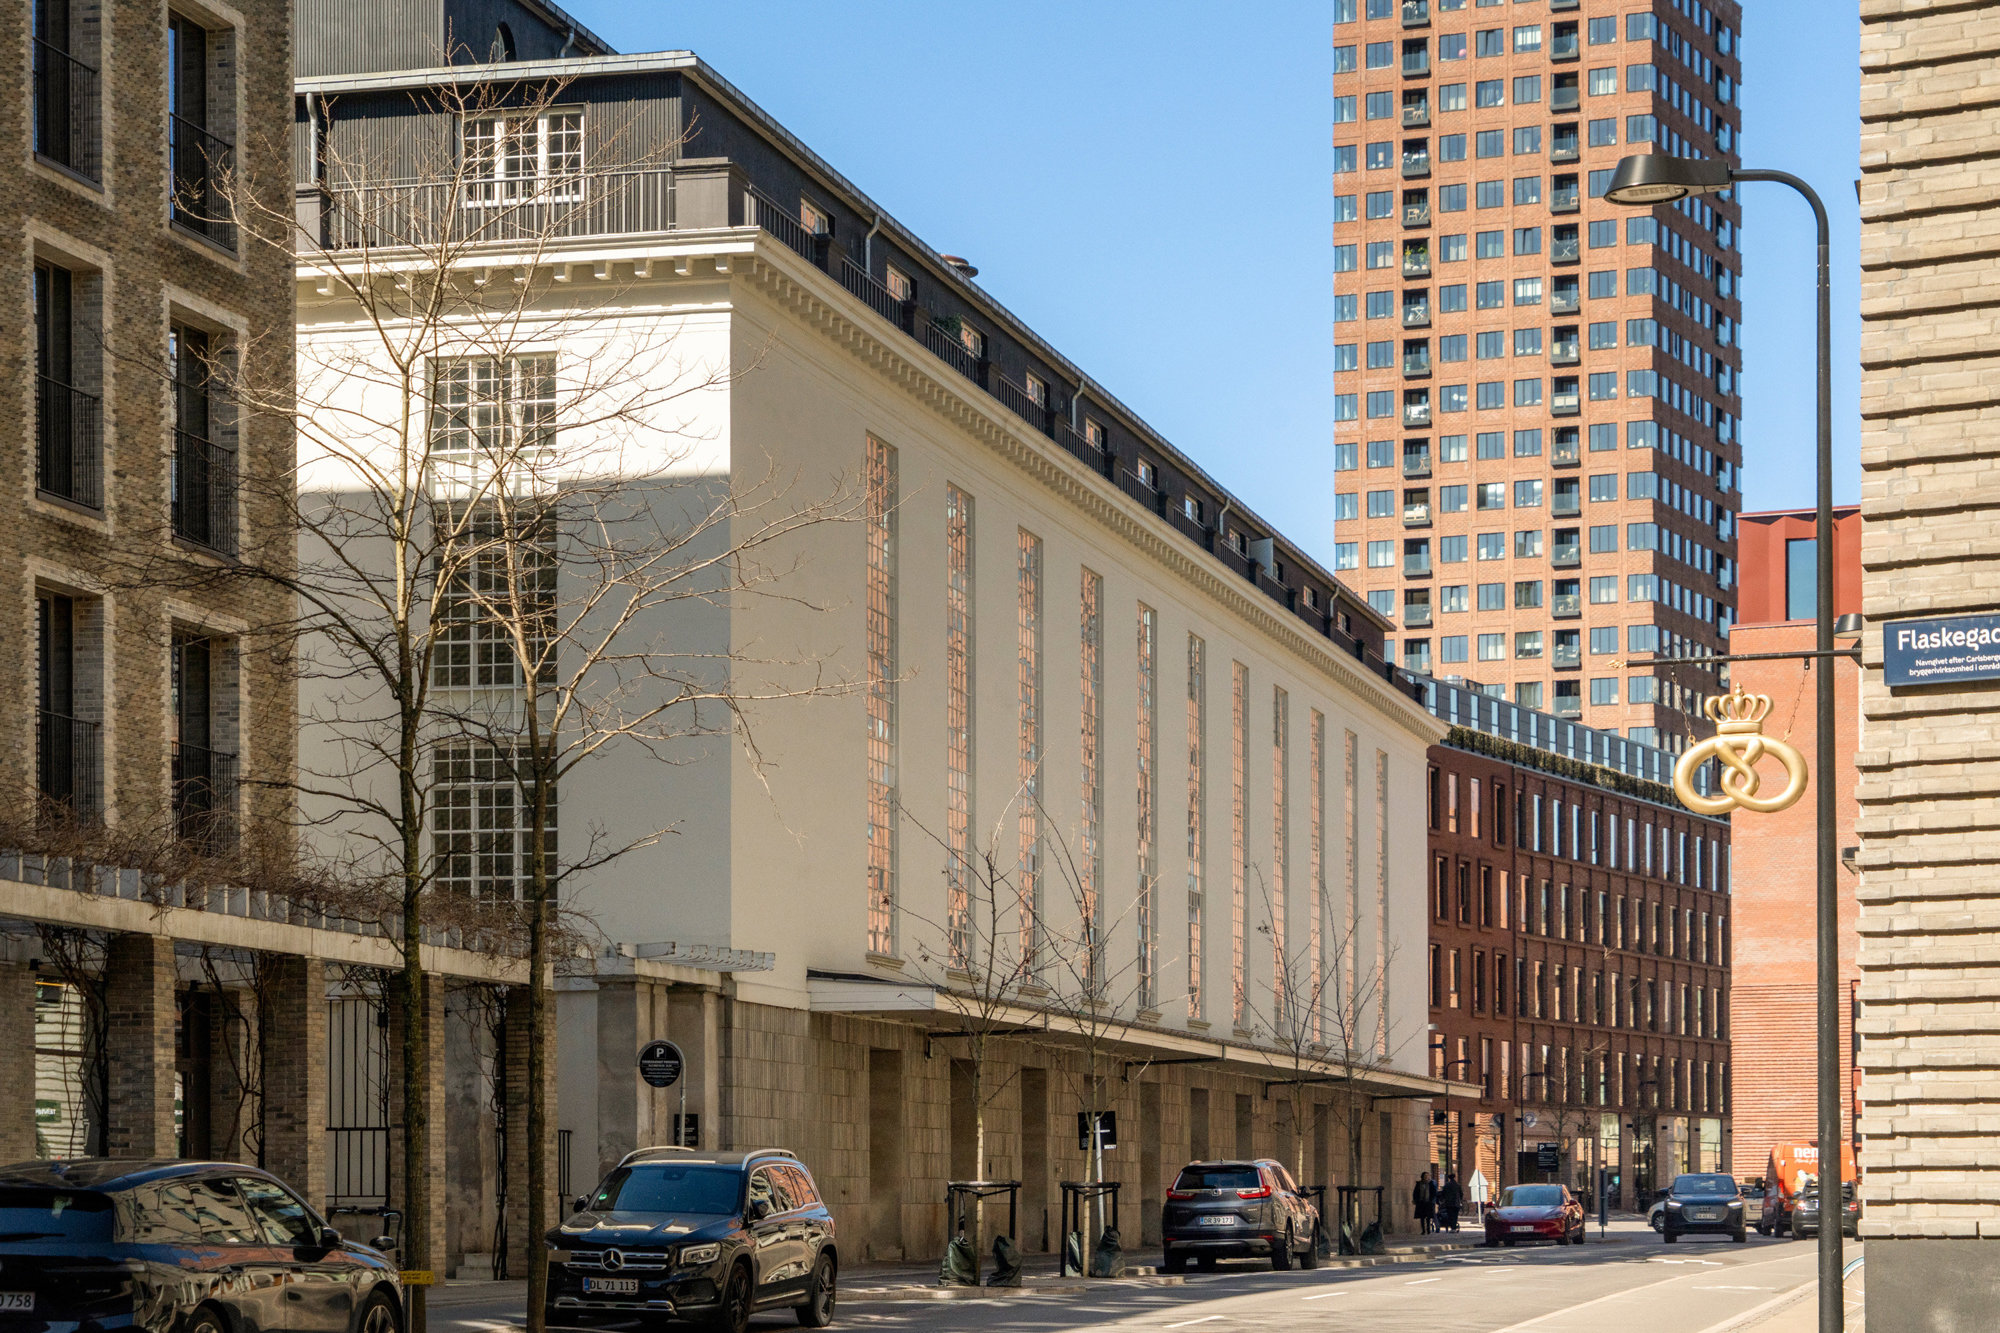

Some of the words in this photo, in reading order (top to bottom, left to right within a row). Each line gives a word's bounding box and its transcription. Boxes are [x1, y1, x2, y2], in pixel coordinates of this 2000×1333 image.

[1916, 657, 1948, 667] Navngivet
[1949, 656, 1965, 664] efter
[656, 1047, 665, 1058] P
[605, 1280, 615, 1290] 71
[619, 1281, 637, 1291] 113
[7, 1295, 32, 1308] 758
